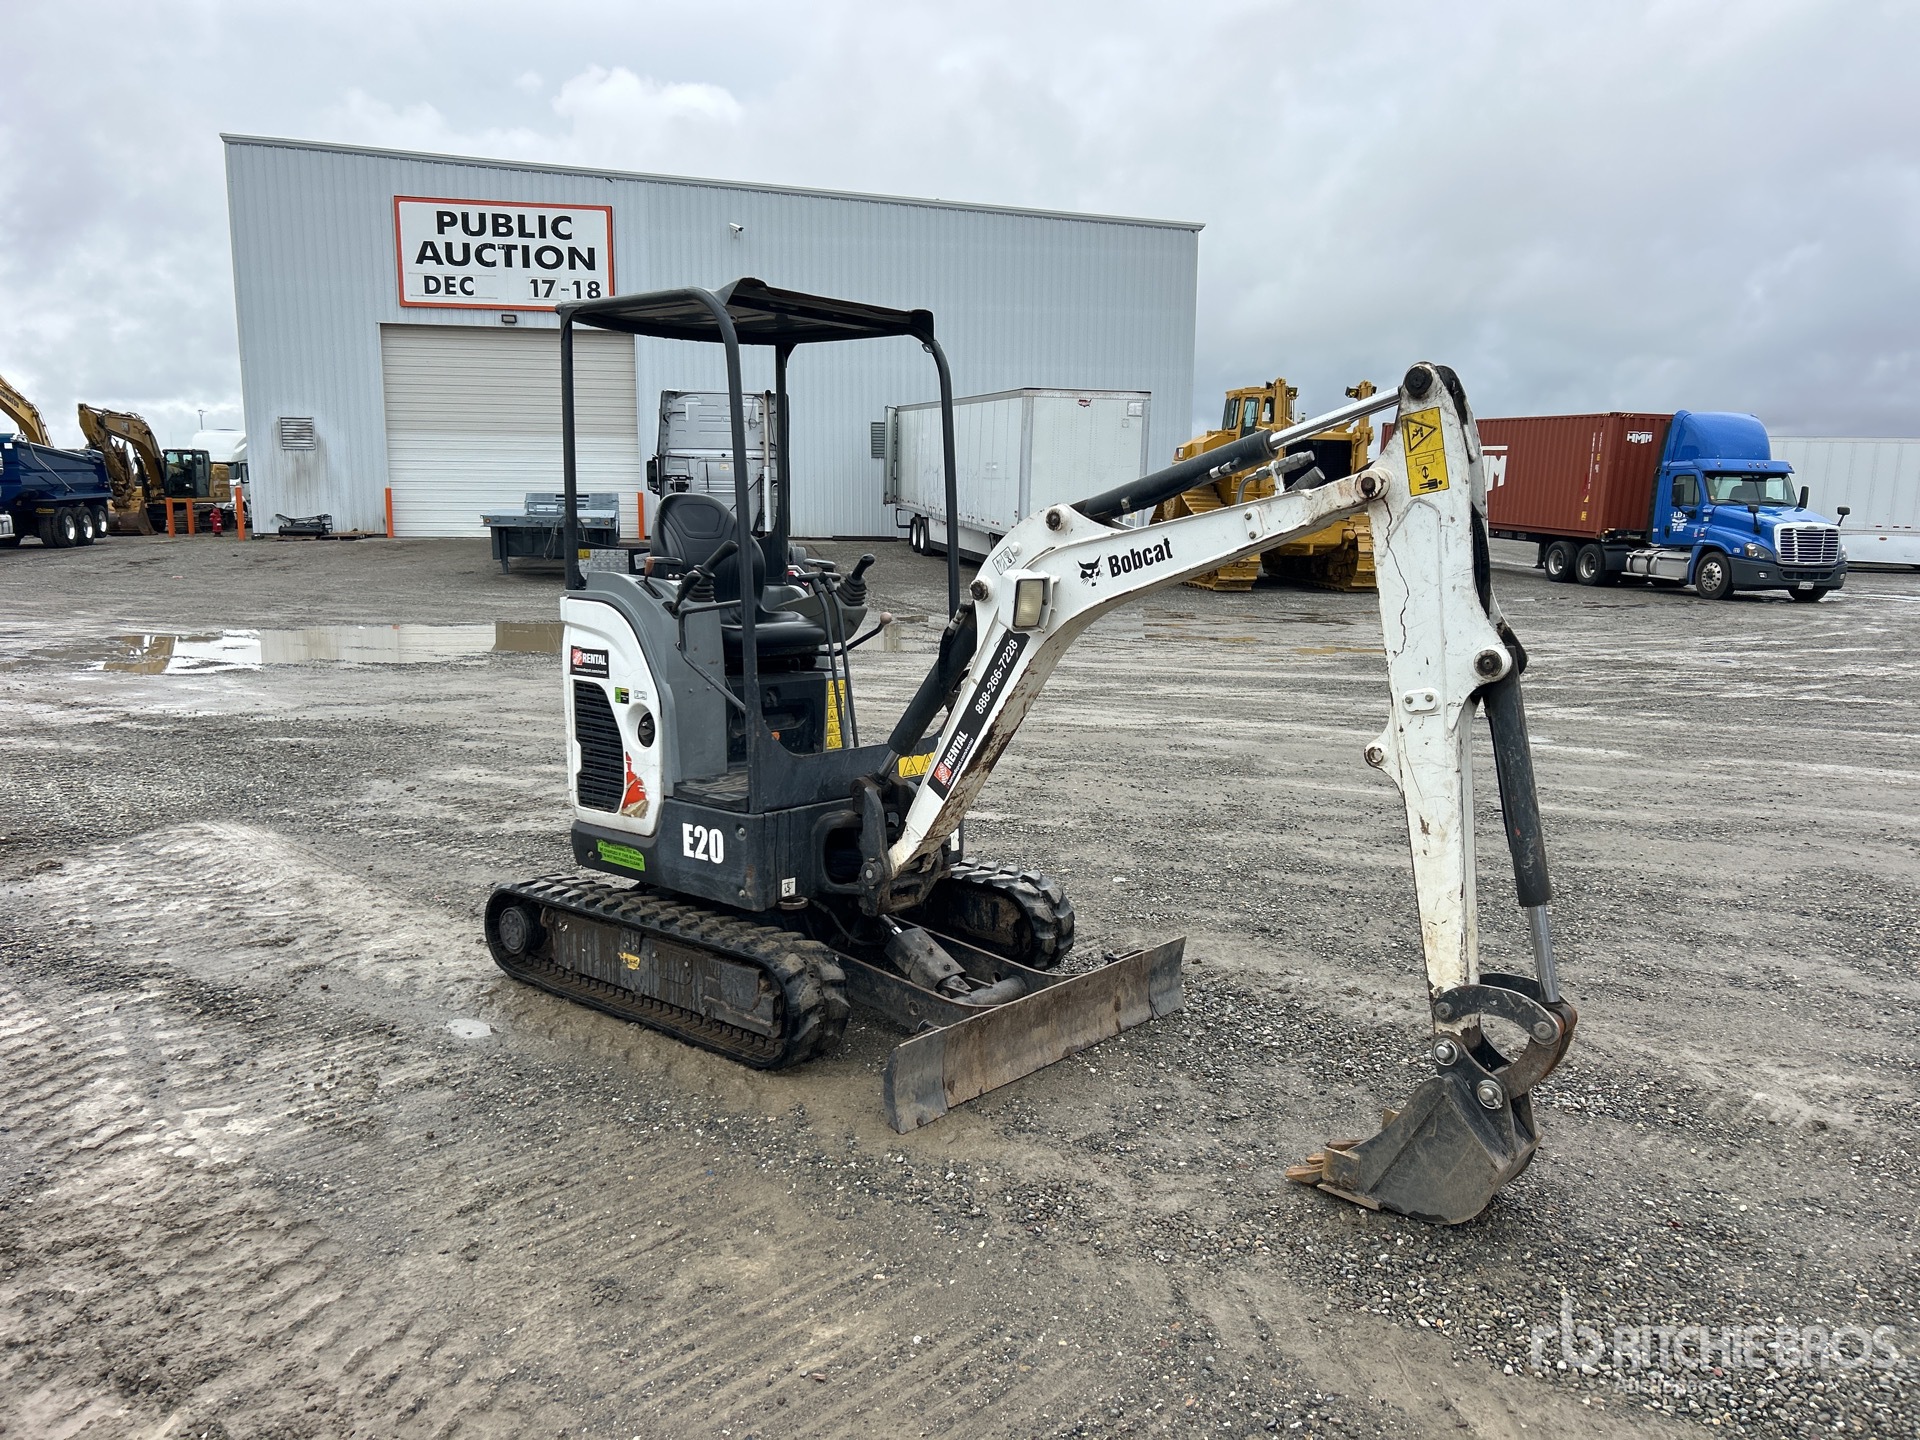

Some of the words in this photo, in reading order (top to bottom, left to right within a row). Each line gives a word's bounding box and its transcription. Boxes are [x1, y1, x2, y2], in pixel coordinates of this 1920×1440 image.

[436, 210, 572, 240] PUBLIC
[415, 240, 596, 271] AUCTION
[424, 275, 475, 296] DEC
[1626, 431, 1652, 444] HMM
[1108, 538, 1173, 578] Bobcat
[582, 653, 606, 665] RENTAL
[975, 639, 1018, 714] 888-266-7228
[944, 730, 968, 768] RENTAL
[682, 822, 724, 864] E20
